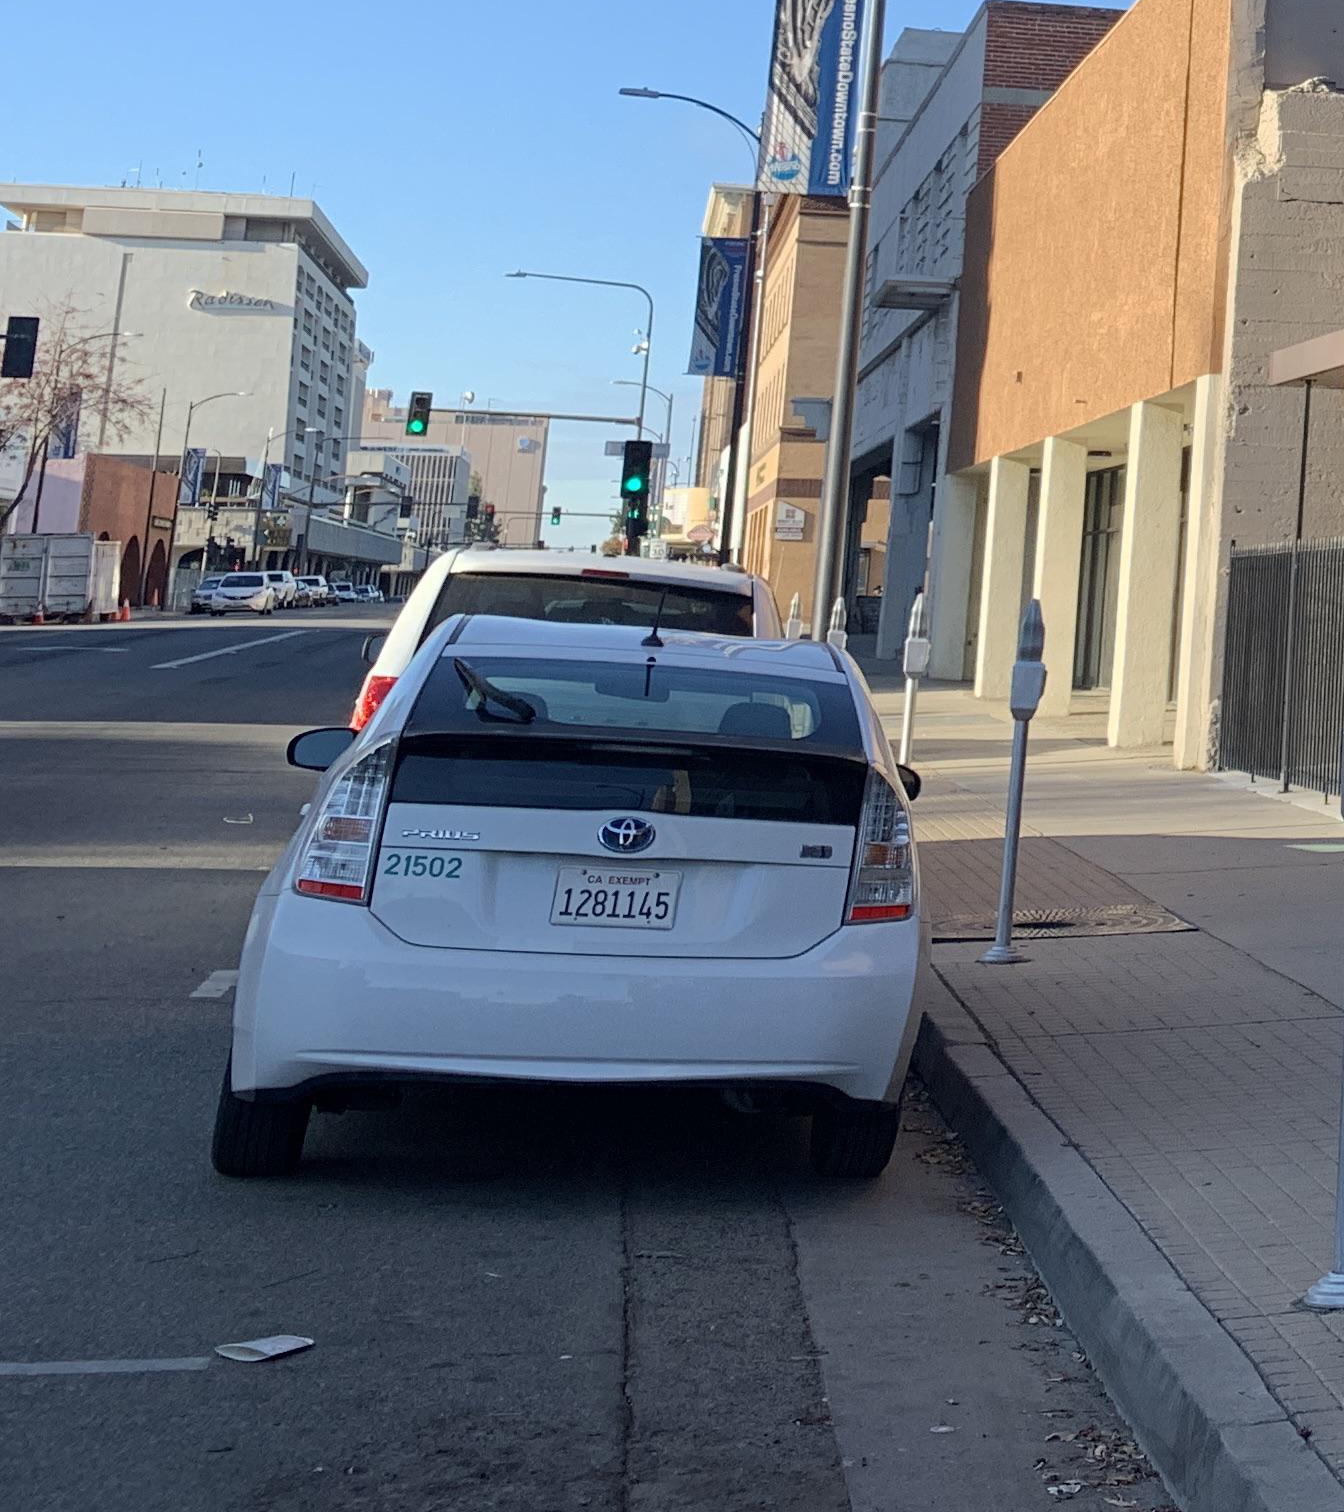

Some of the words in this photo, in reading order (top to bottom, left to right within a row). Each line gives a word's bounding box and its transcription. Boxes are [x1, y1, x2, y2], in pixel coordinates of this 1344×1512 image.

[189, 289, 274, 309] Radisson
[402, 829, 480, 841] PRIUS
[384, 853, 463, 878] 21502
[587, 875, 602, 884] CA
[608, 876, 651, 885] EXEMPT
[559, 888, 670, 919] 1281145
